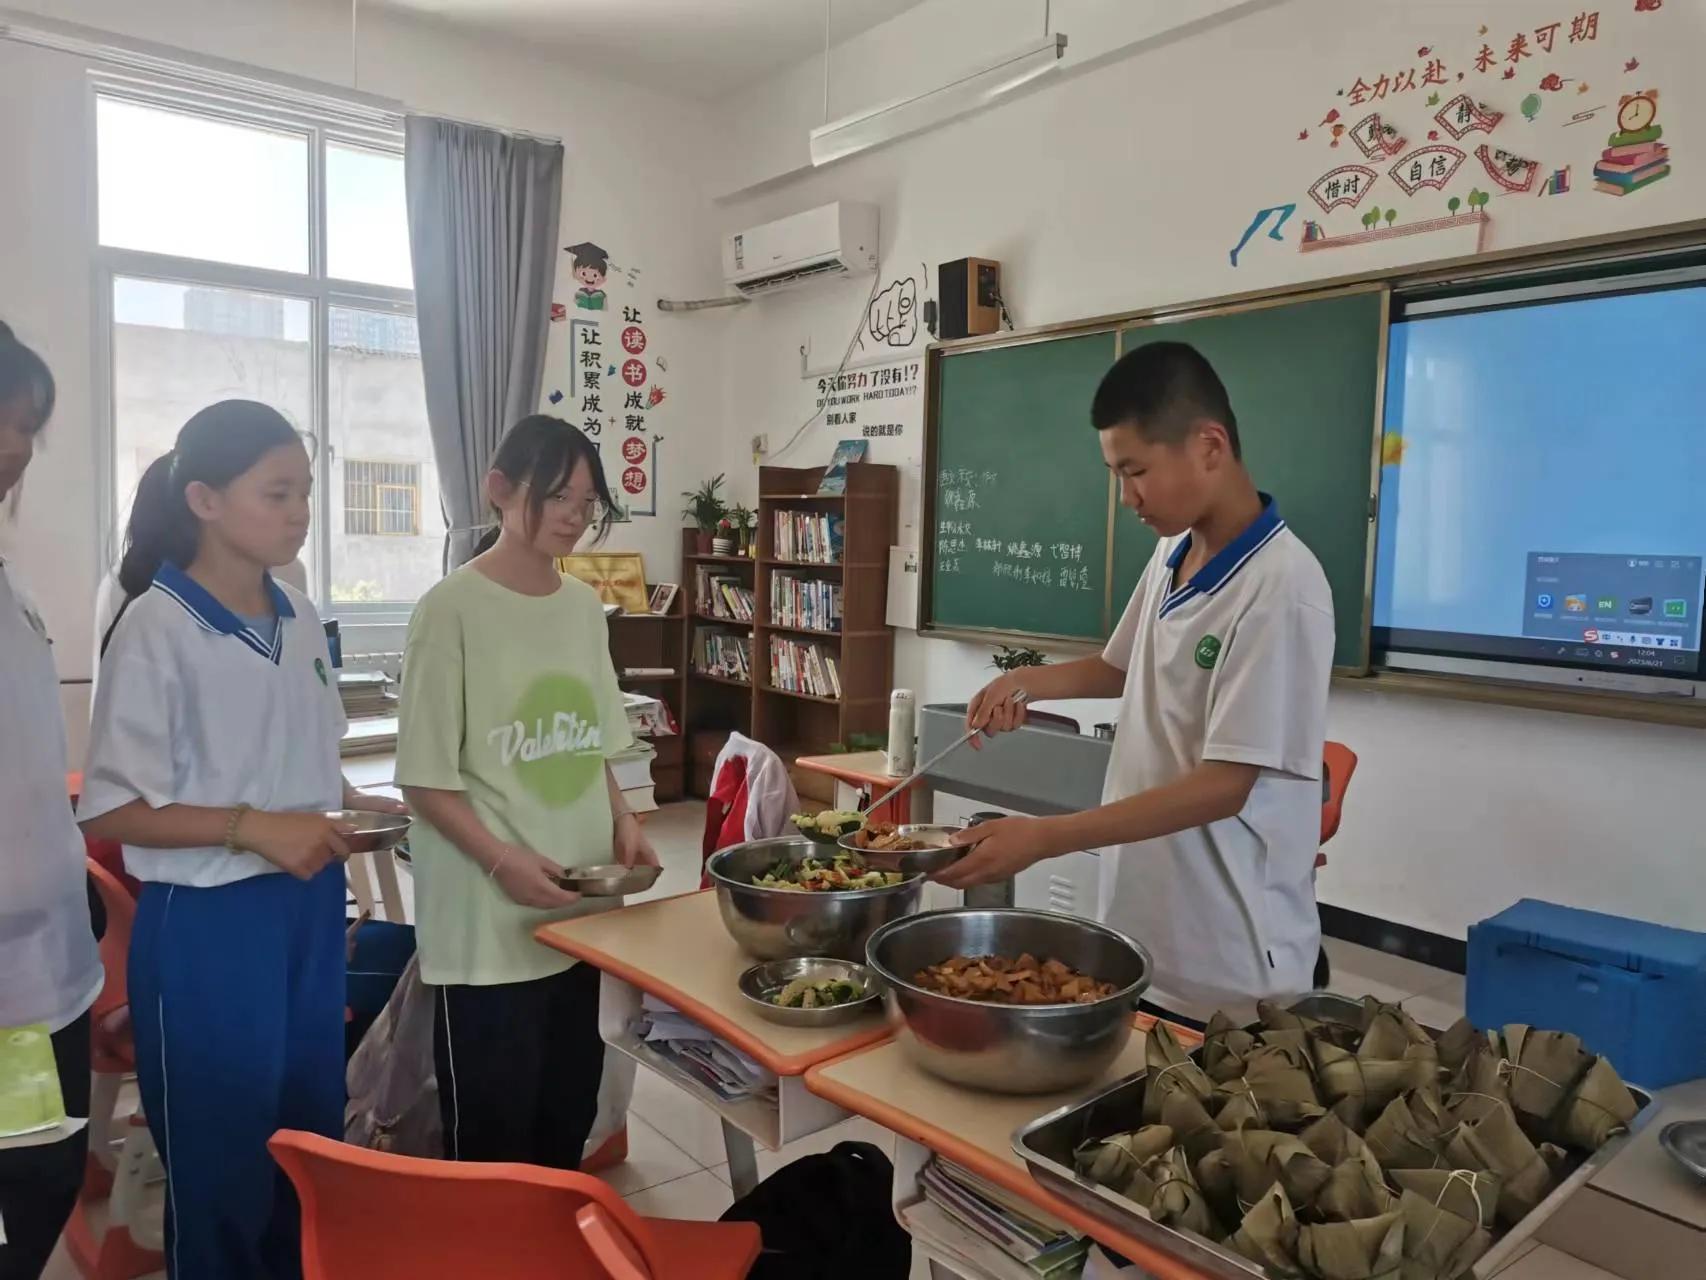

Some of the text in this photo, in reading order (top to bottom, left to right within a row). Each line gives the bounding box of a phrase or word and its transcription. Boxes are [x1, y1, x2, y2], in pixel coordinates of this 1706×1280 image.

[1410, 155, 1448, 182] 自信
[1324, 176, 1361, 201] 惜时
[621, 305, 647, 491] 让读书成就梦想
[841, 394, 860, 405] WORK
[863, 389, 884, 400] HARD
[826, 411, 857, 425] 别看人家
[862, 424, 904, 437] 说的就是你
[1598, 600, 1612, 609] EN
